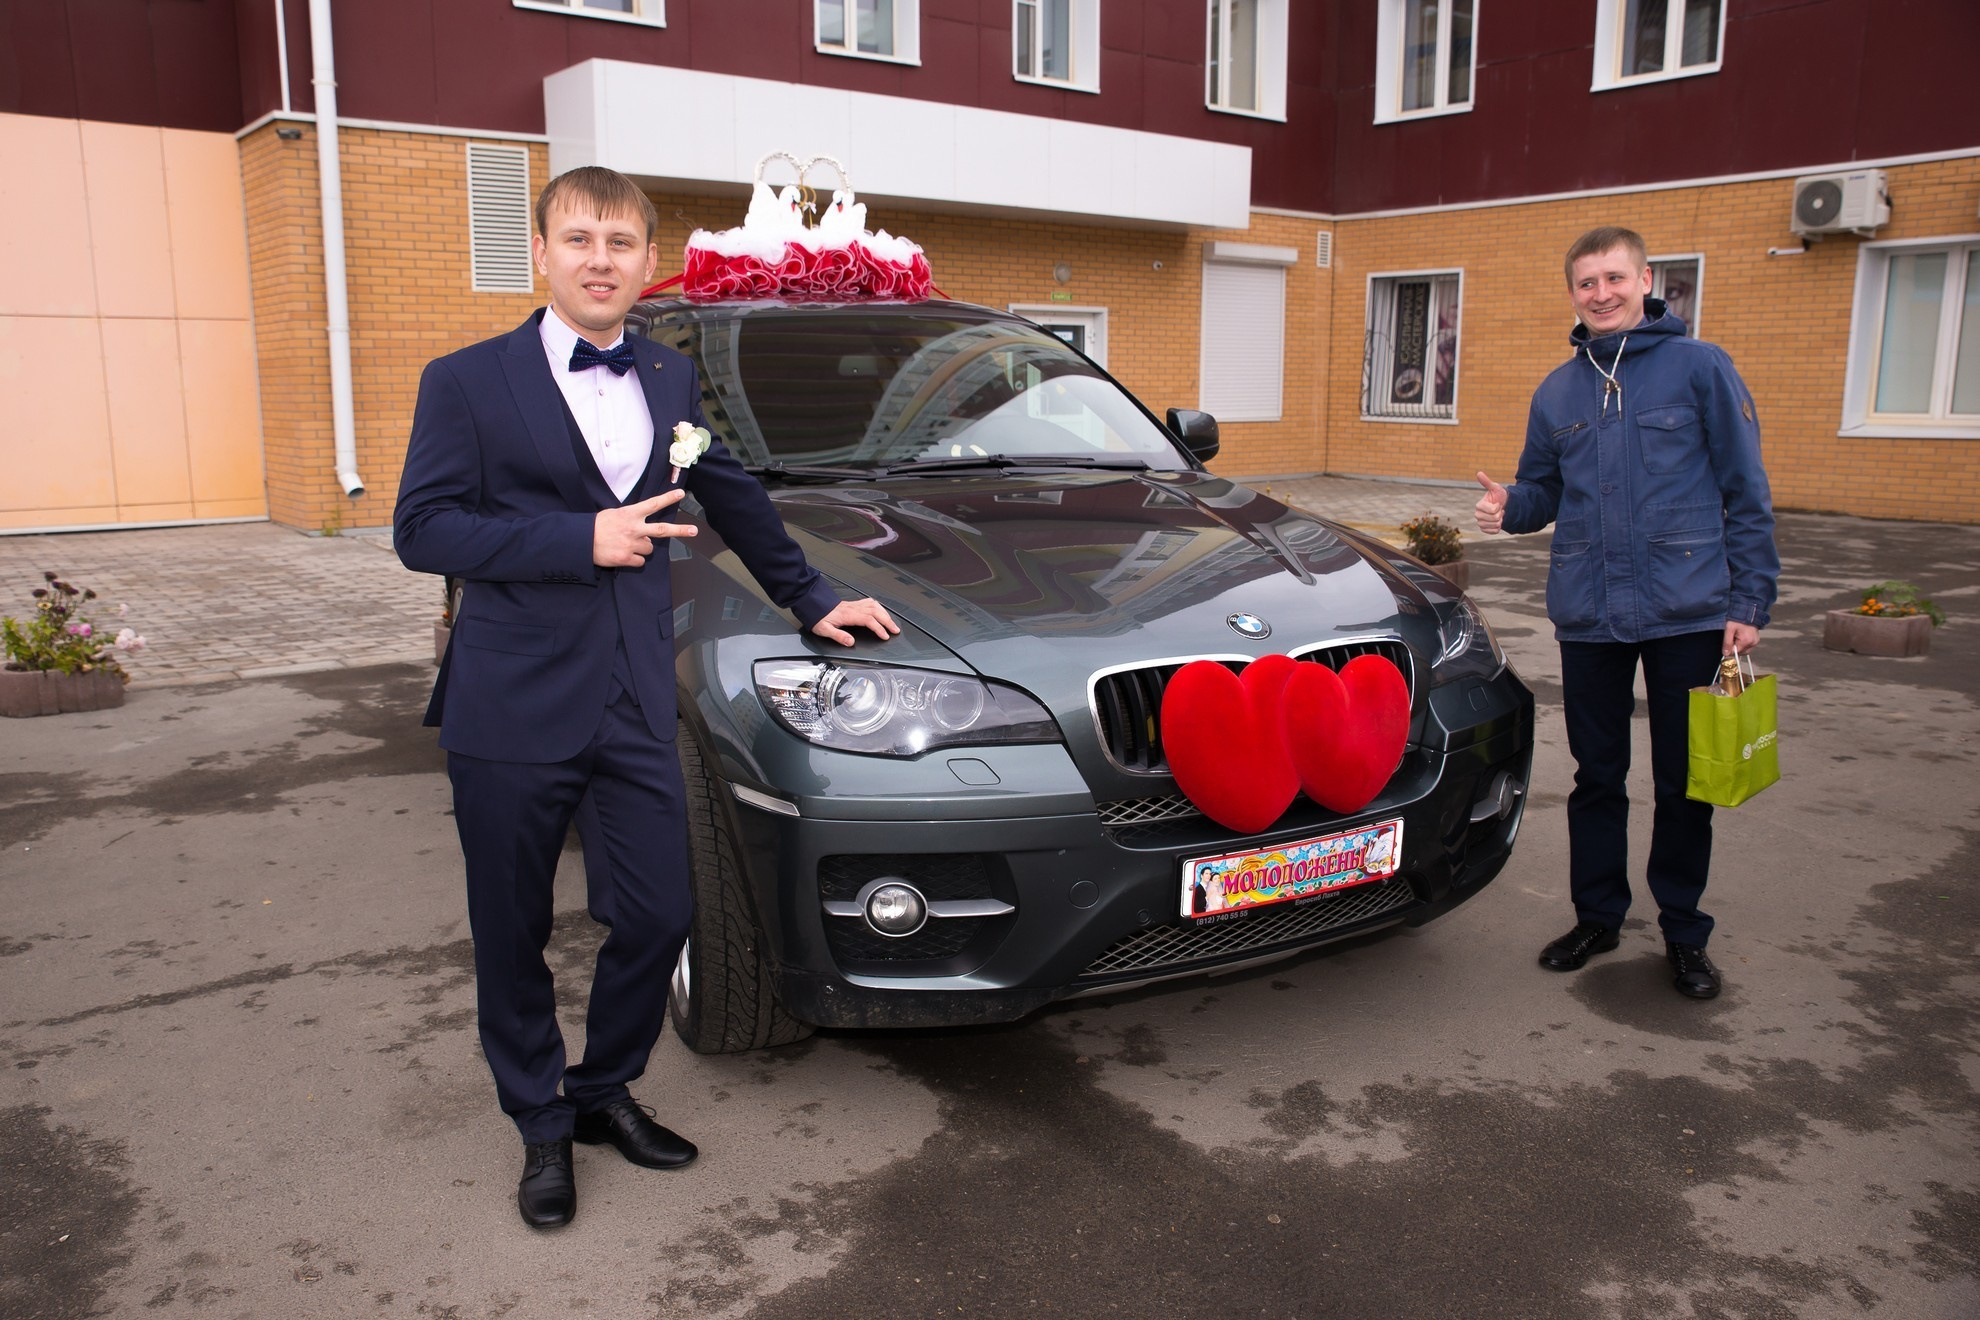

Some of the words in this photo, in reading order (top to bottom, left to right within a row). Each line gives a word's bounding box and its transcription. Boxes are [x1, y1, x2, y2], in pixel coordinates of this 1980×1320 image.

[1196, 915, 1215, 926] (812)
[1216, 913, 1229, 922] 740
[1230, 911, 1239, 919] 55
[1240, 909, 1249, 917] 55
